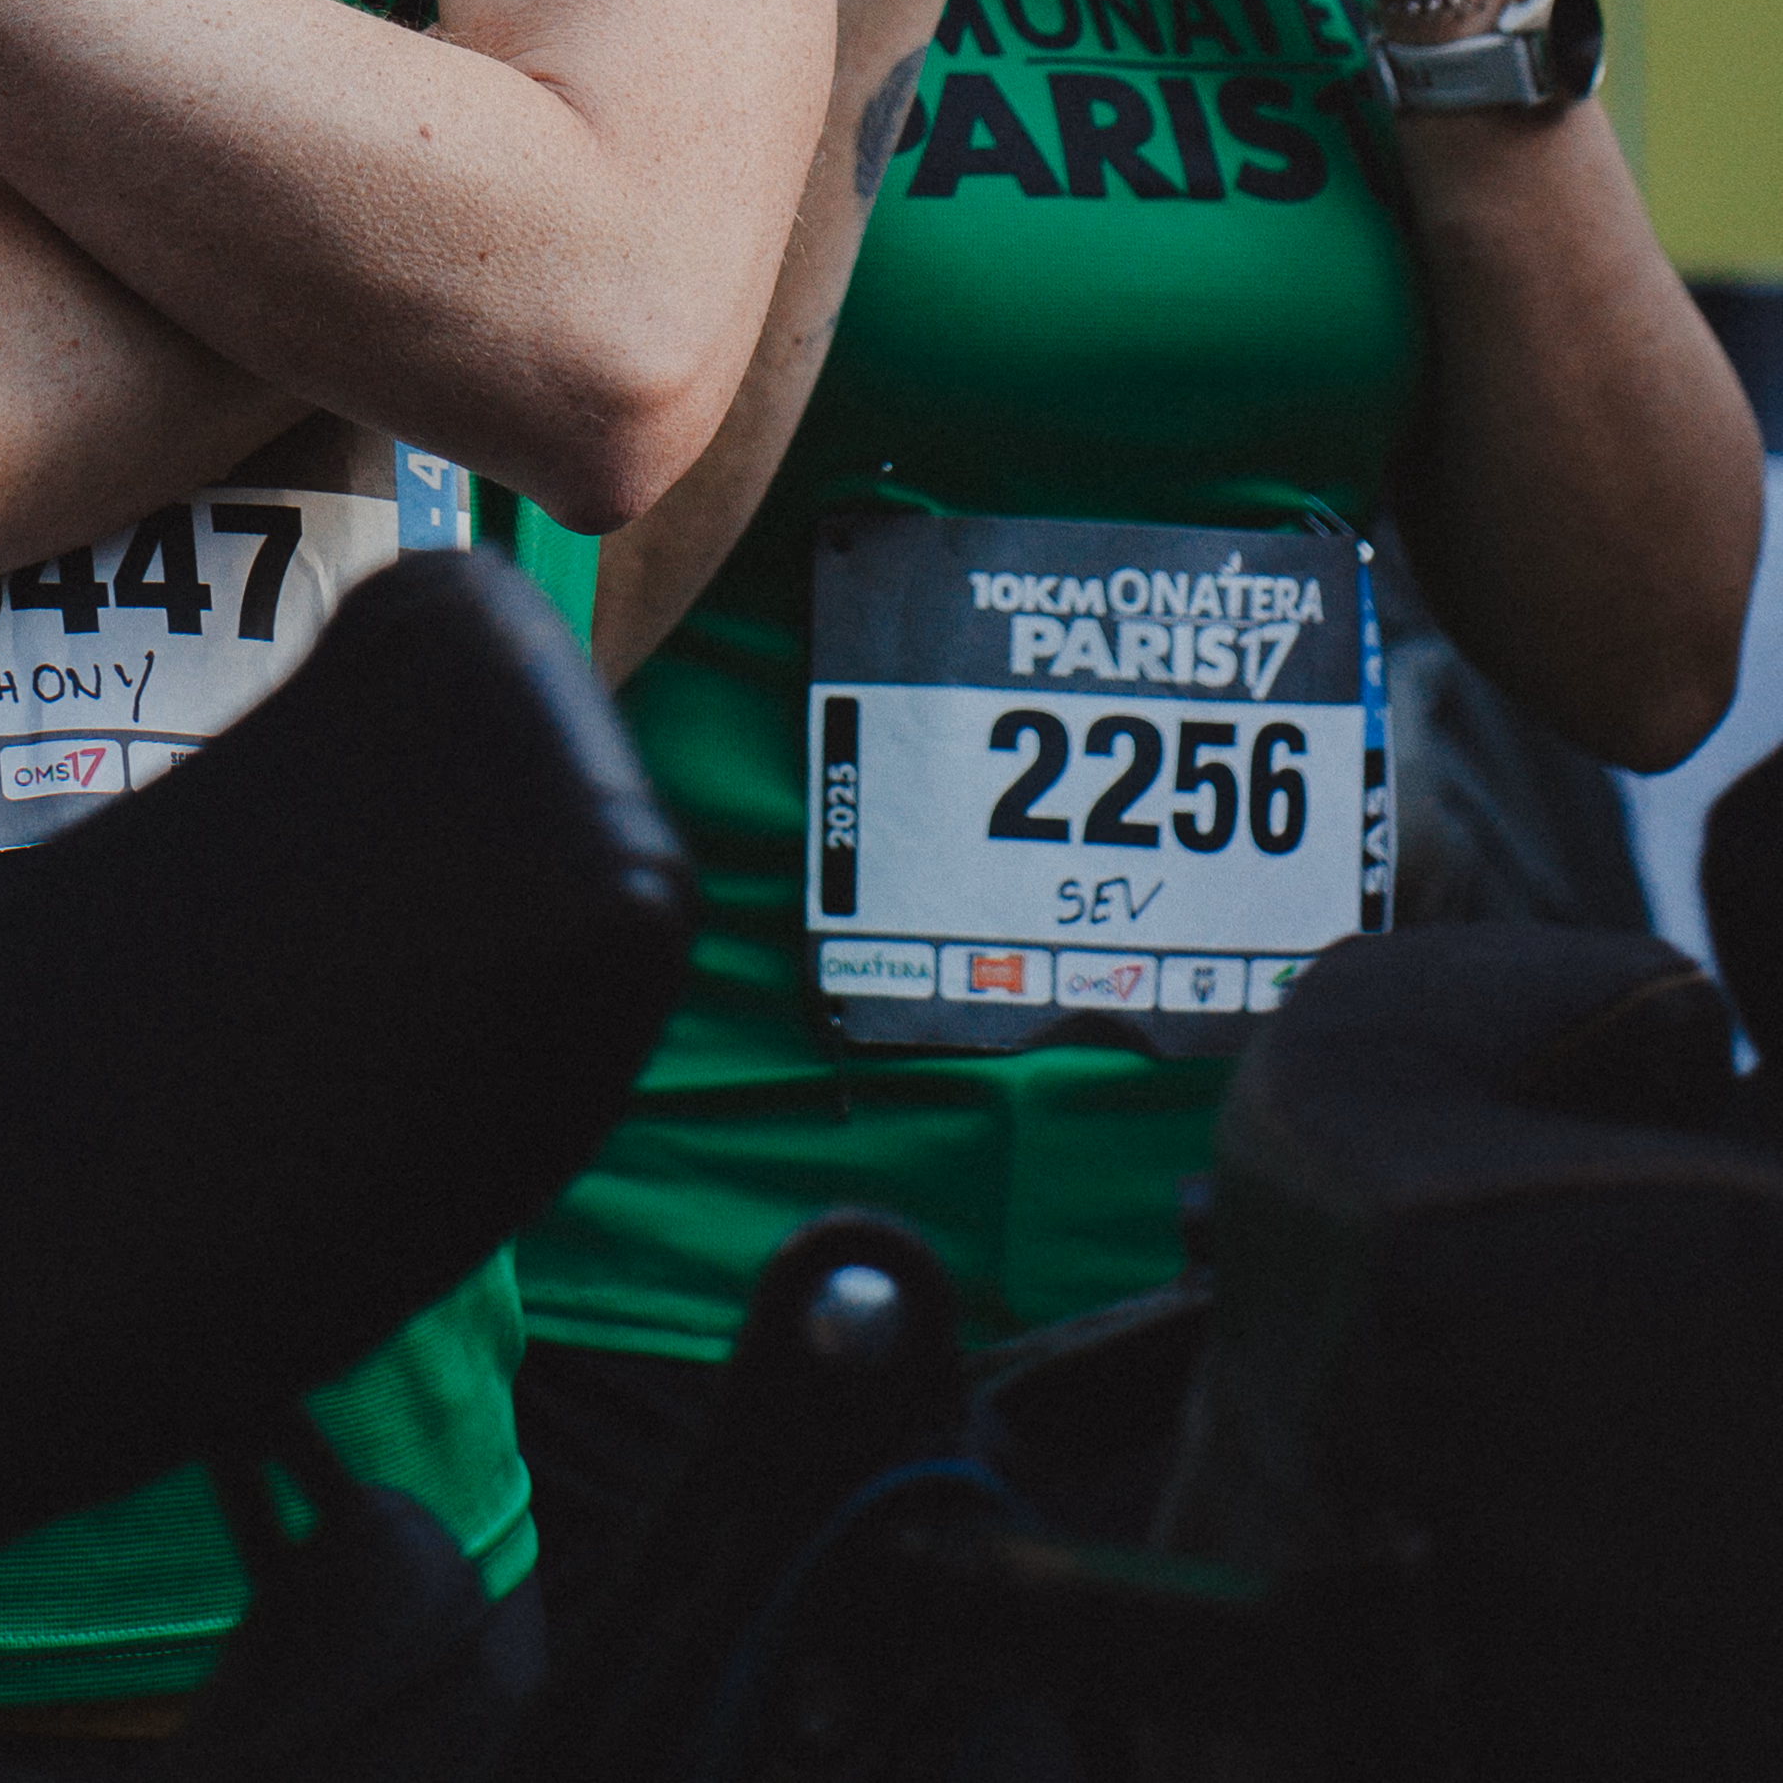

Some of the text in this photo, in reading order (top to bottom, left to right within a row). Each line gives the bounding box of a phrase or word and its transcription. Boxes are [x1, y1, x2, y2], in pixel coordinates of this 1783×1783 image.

[826, 761, 858, 850] 2025
[987, 708, 1309, 856] 2256
[1056, 876, 1164, 925] SEV
